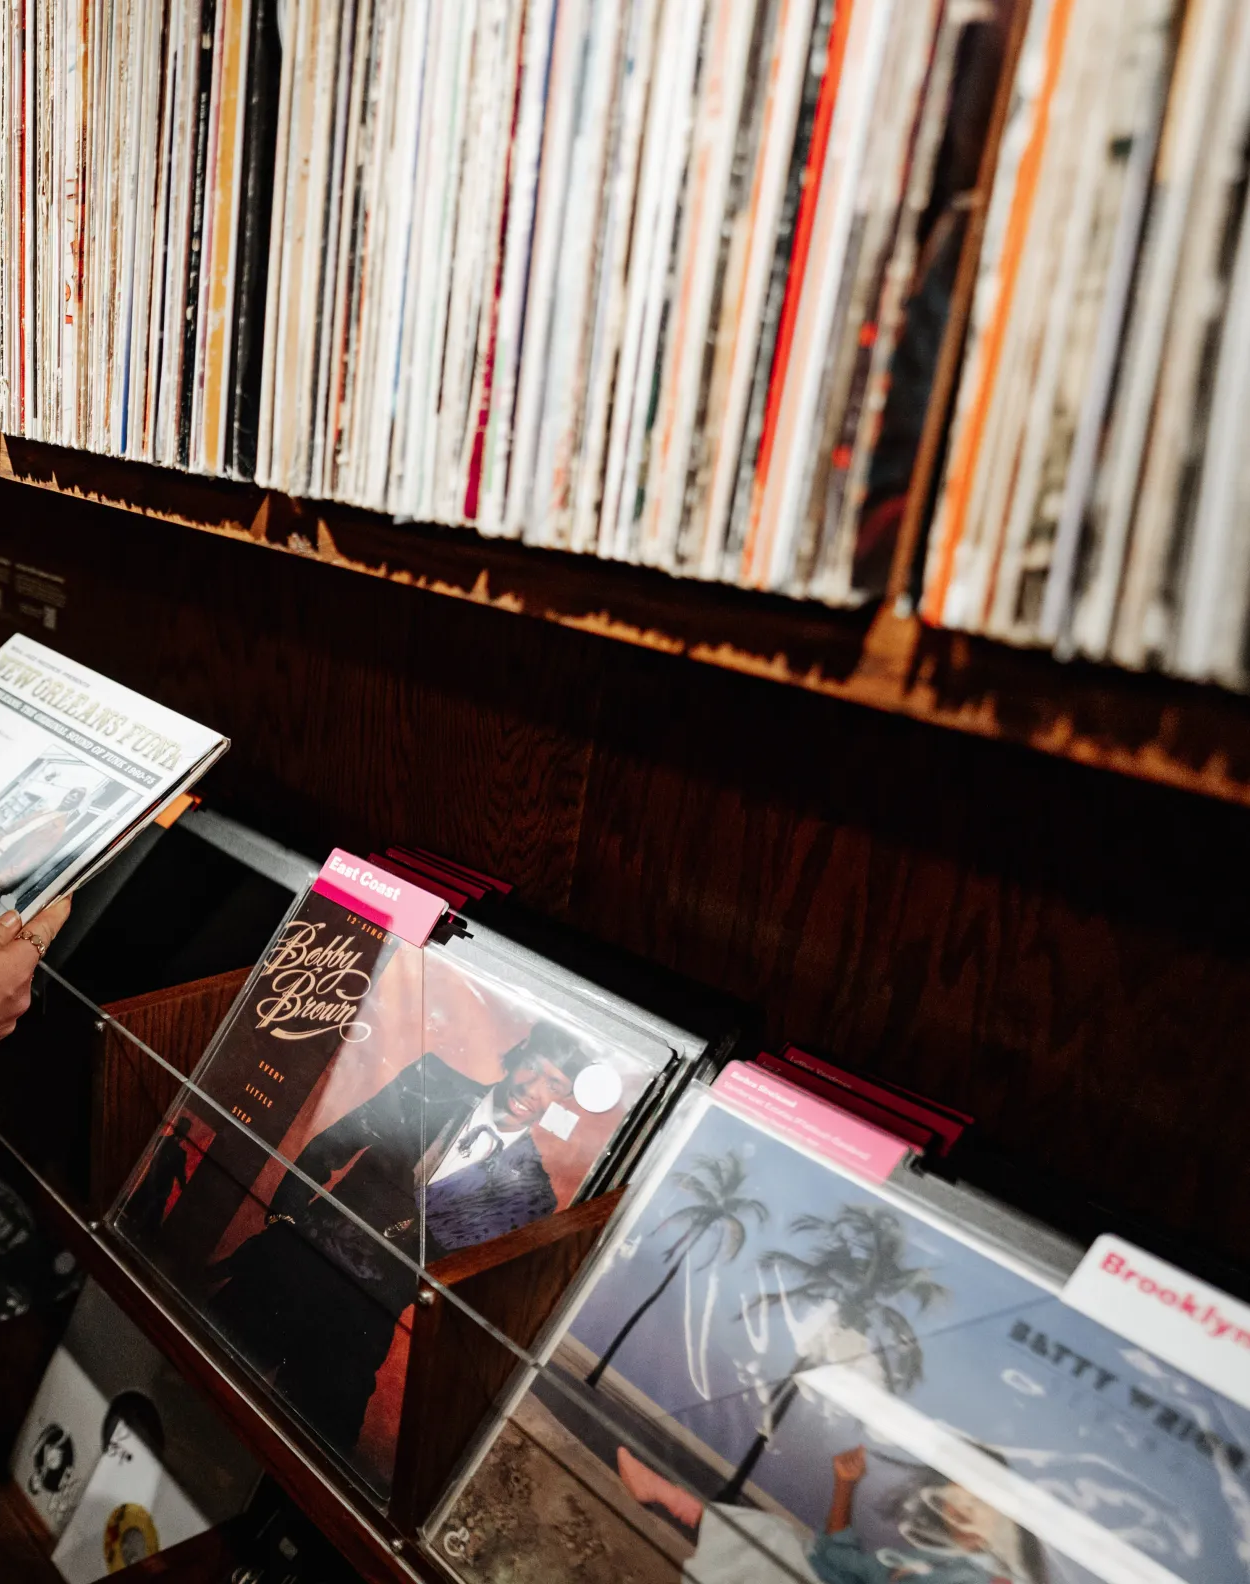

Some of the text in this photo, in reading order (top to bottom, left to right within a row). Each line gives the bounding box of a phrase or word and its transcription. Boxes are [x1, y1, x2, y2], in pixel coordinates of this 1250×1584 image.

[19, 703, 38, 718] THE
[32, 710, 70, 736] ORIGINAL
[64, 730, 95, 750] SOUND
[89, 744, 106, 757] OF
[100, 750, 127, 769] FUNK
[122, 763, 156, 785] 1960-75
[29, 674, 131, 739] ORLEANS
[115, 720, 194, 772] FUNK
[327, 855, 401, 901] East Coast
[263, 920, 371, 1000] Bobby
[361, 923, 394, 946] SINGLE
[255, 967, 372, 1043] Brown
[245, 1083, 274, 1109] LITTLE
[258, 1060, 285, 1084] EVERY
[231, 1105, 252, 1125] STEP
[1098, 1250, 1250, 1350] Brooklyn
[1008, 1318, 1120, 1393] BETTY
